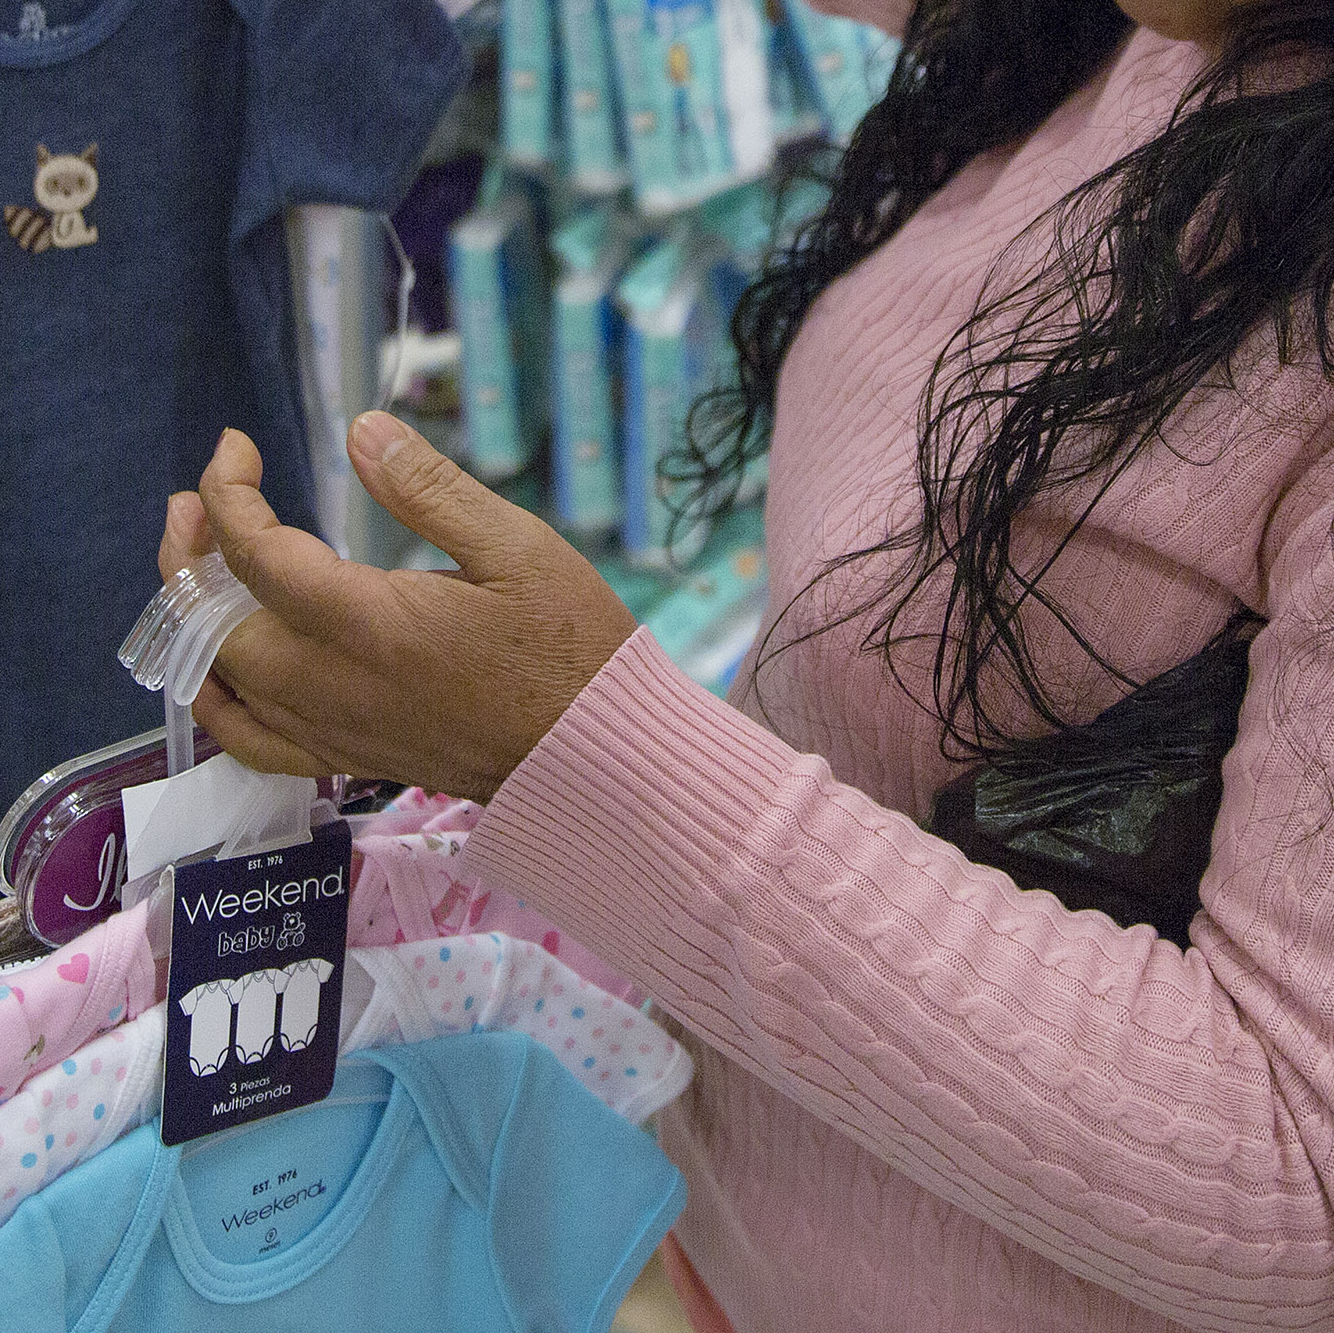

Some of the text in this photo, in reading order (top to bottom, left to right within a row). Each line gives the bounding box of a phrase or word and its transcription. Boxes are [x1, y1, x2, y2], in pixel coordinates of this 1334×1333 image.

[248, 855, 284, 870] EST. 1976
[181, 866, 345, 925] Weekend
[218, 925, 275, 957] baby
[212, 1084, 292, 1116] Multiprenda
[229, 1076, 271, 1095] 3 Piezas
[252, 1168, 298, 1196] EST. 1976
[221, 1178, 325, 1233] Weekend
